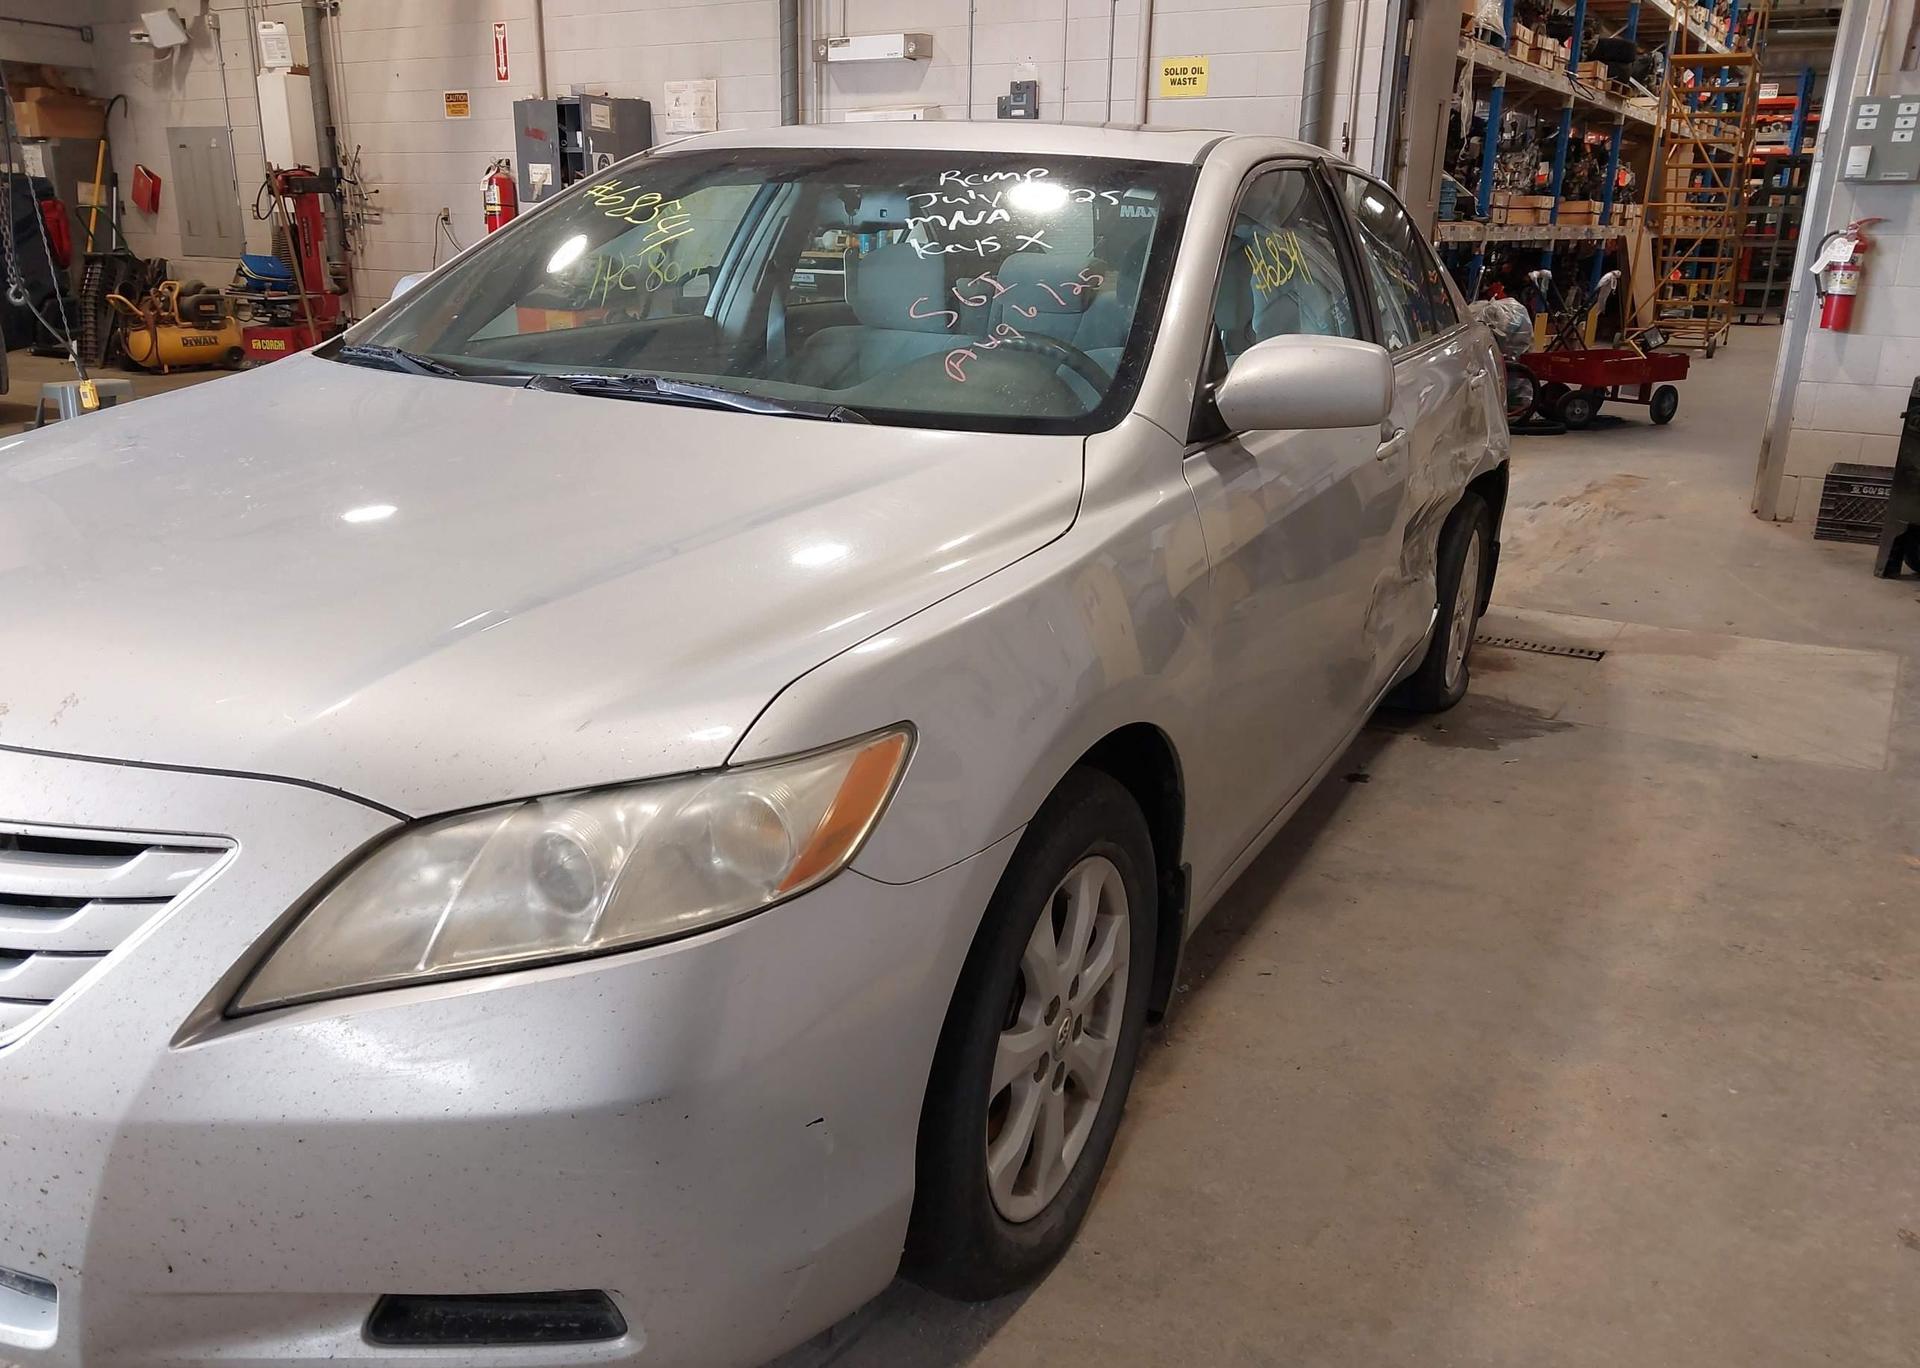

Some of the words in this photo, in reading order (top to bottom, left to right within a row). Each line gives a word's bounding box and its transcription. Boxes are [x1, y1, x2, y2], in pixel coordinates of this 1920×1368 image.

[1164, 67, 1188, 76] SOLID
[1191, 66, 1204, 75] OIL
[1169, 77, 1197, 86] WASTE
